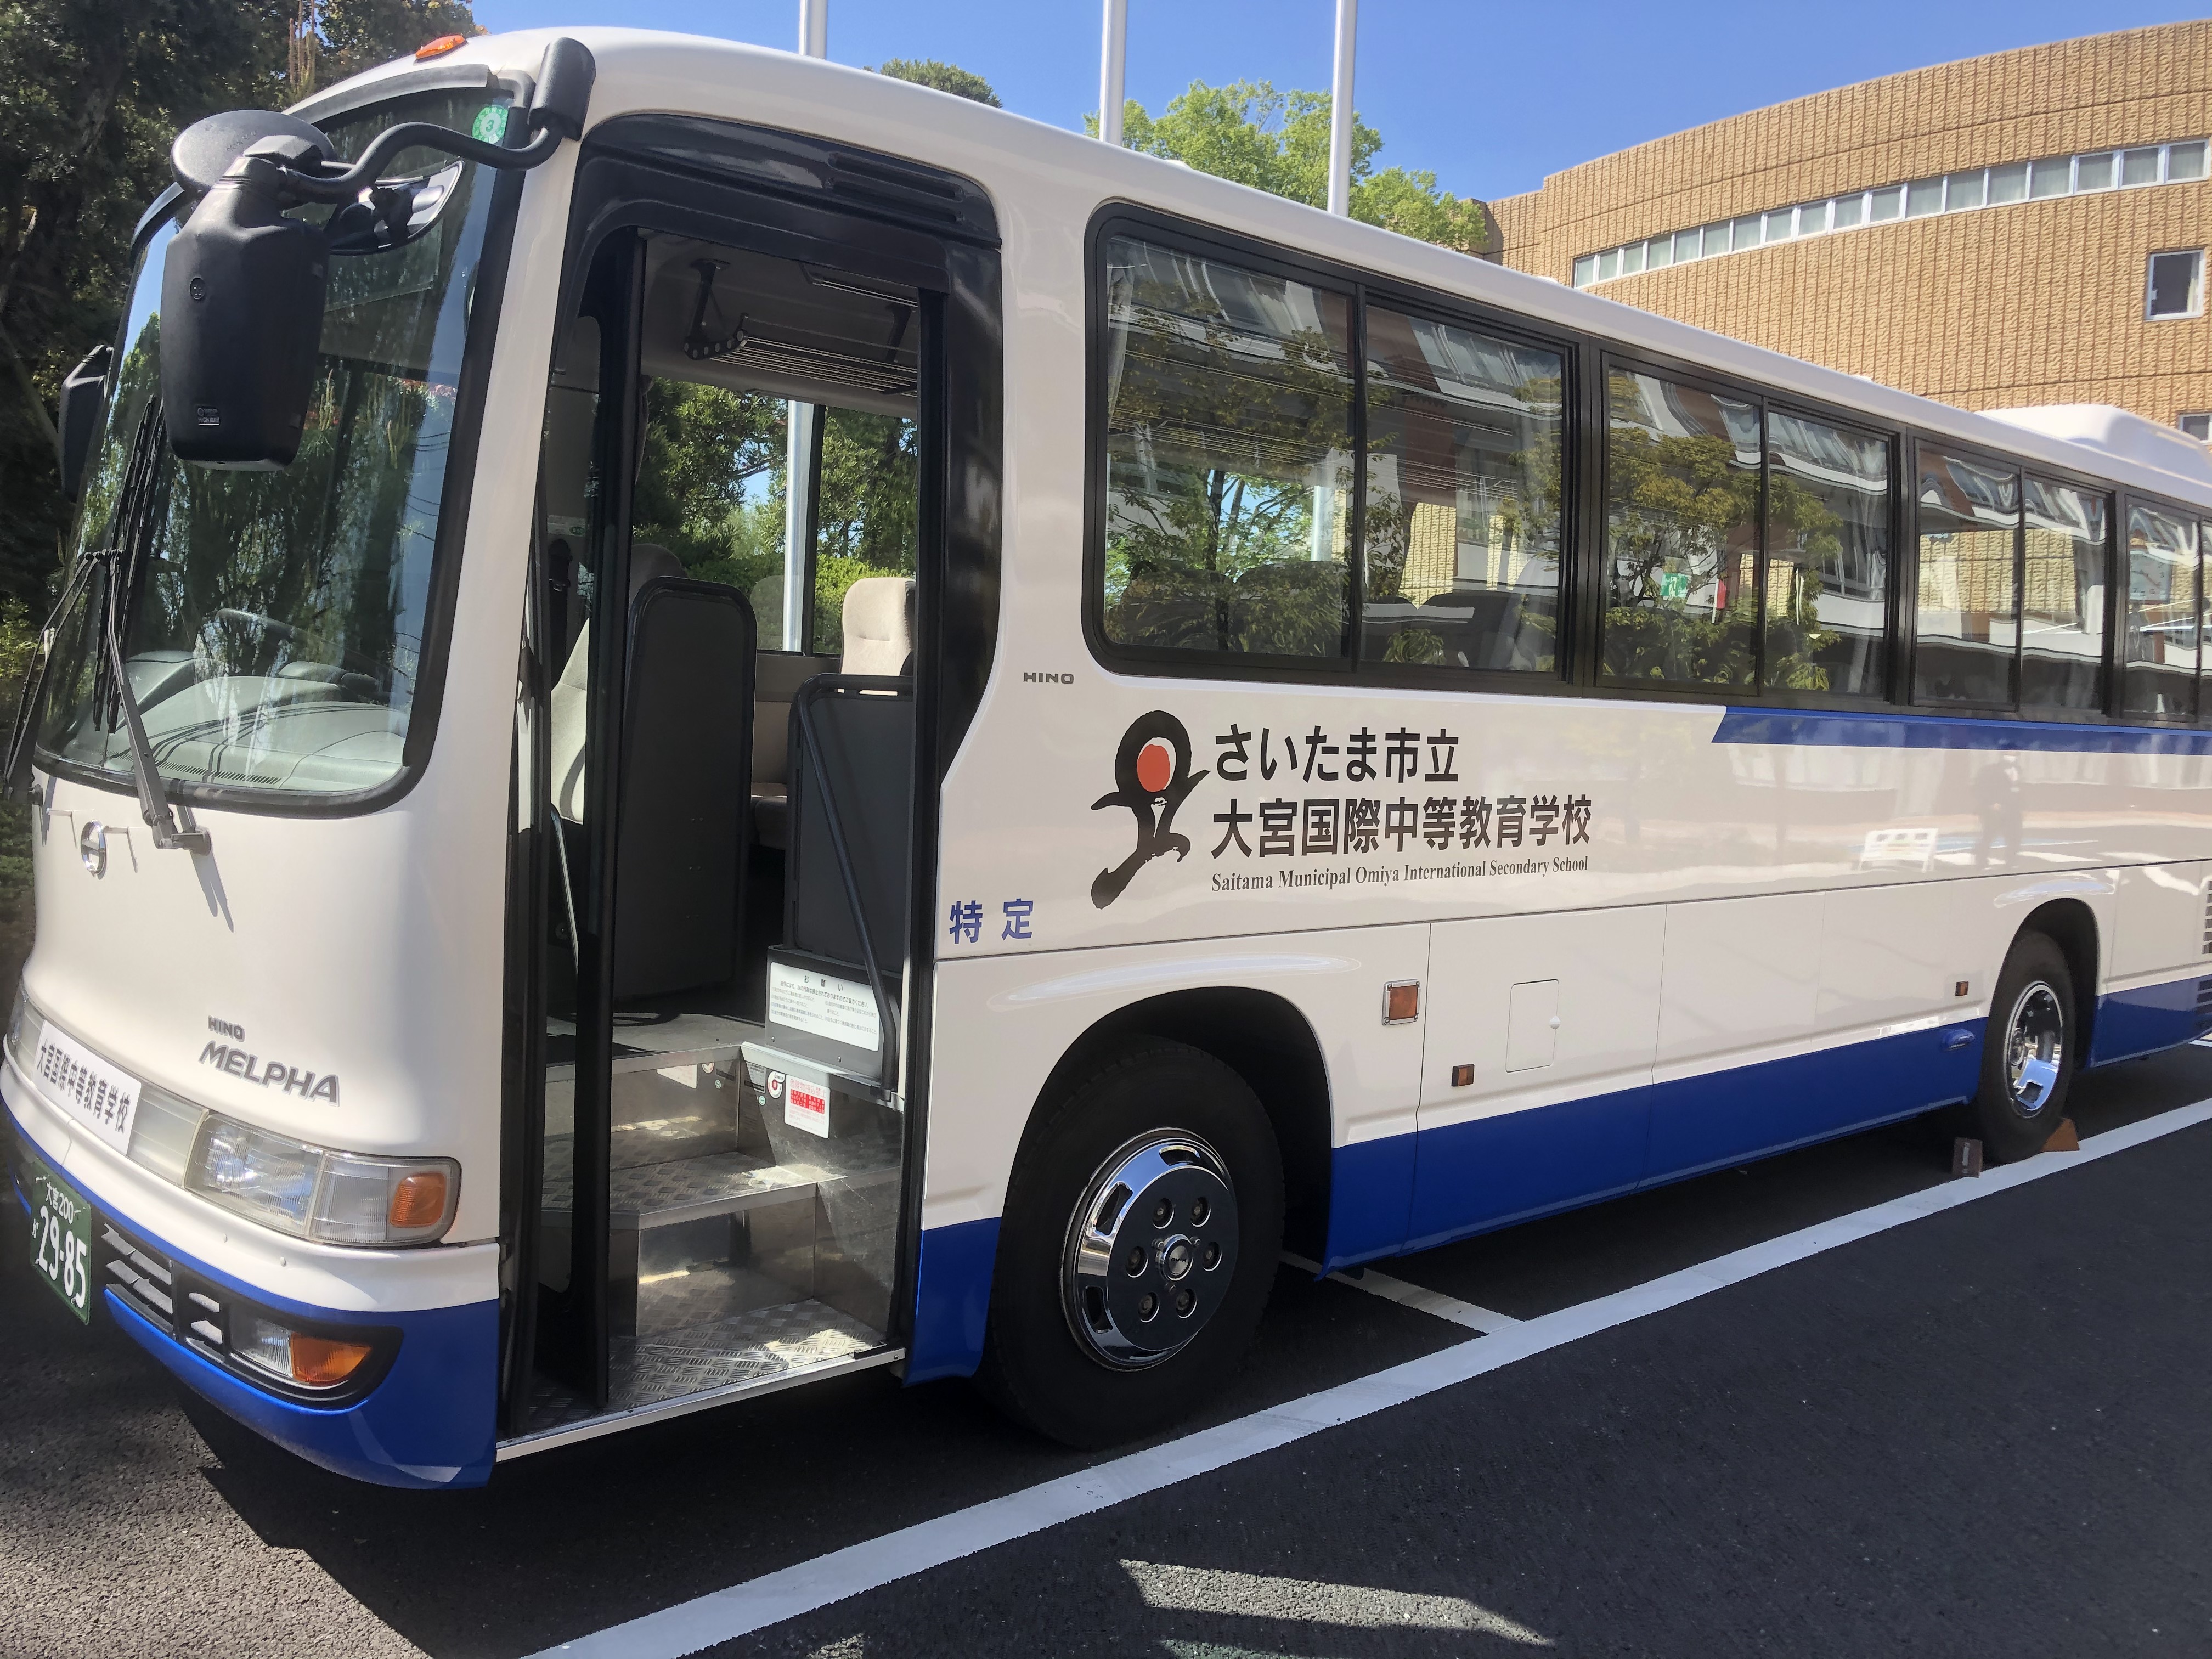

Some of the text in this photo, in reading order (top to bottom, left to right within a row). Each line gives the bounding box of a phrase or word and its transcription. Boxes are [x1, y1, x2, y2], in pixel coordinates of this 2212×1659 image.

[486, 120, 494, 132] 3
[1024, 672, 1074, 684] HINO
[1215, 723, 1459, 783] さいたま市立
[1211, 794, 1592, 860] 大宮国際中等教育学校
[1212, 855, 1588, 891] Saitama Municipal Omiya International Secondary School
[208, 1015, 245, 1042] HINO
[37, 1037, 131, 1135] 大宮国際中等教育学校
[199, 1040, 340, 1107] MELPHA
[789, 1079, 826, 1098] 危険物持込禁止
[39, 1205, 87, 1308] 29-85
